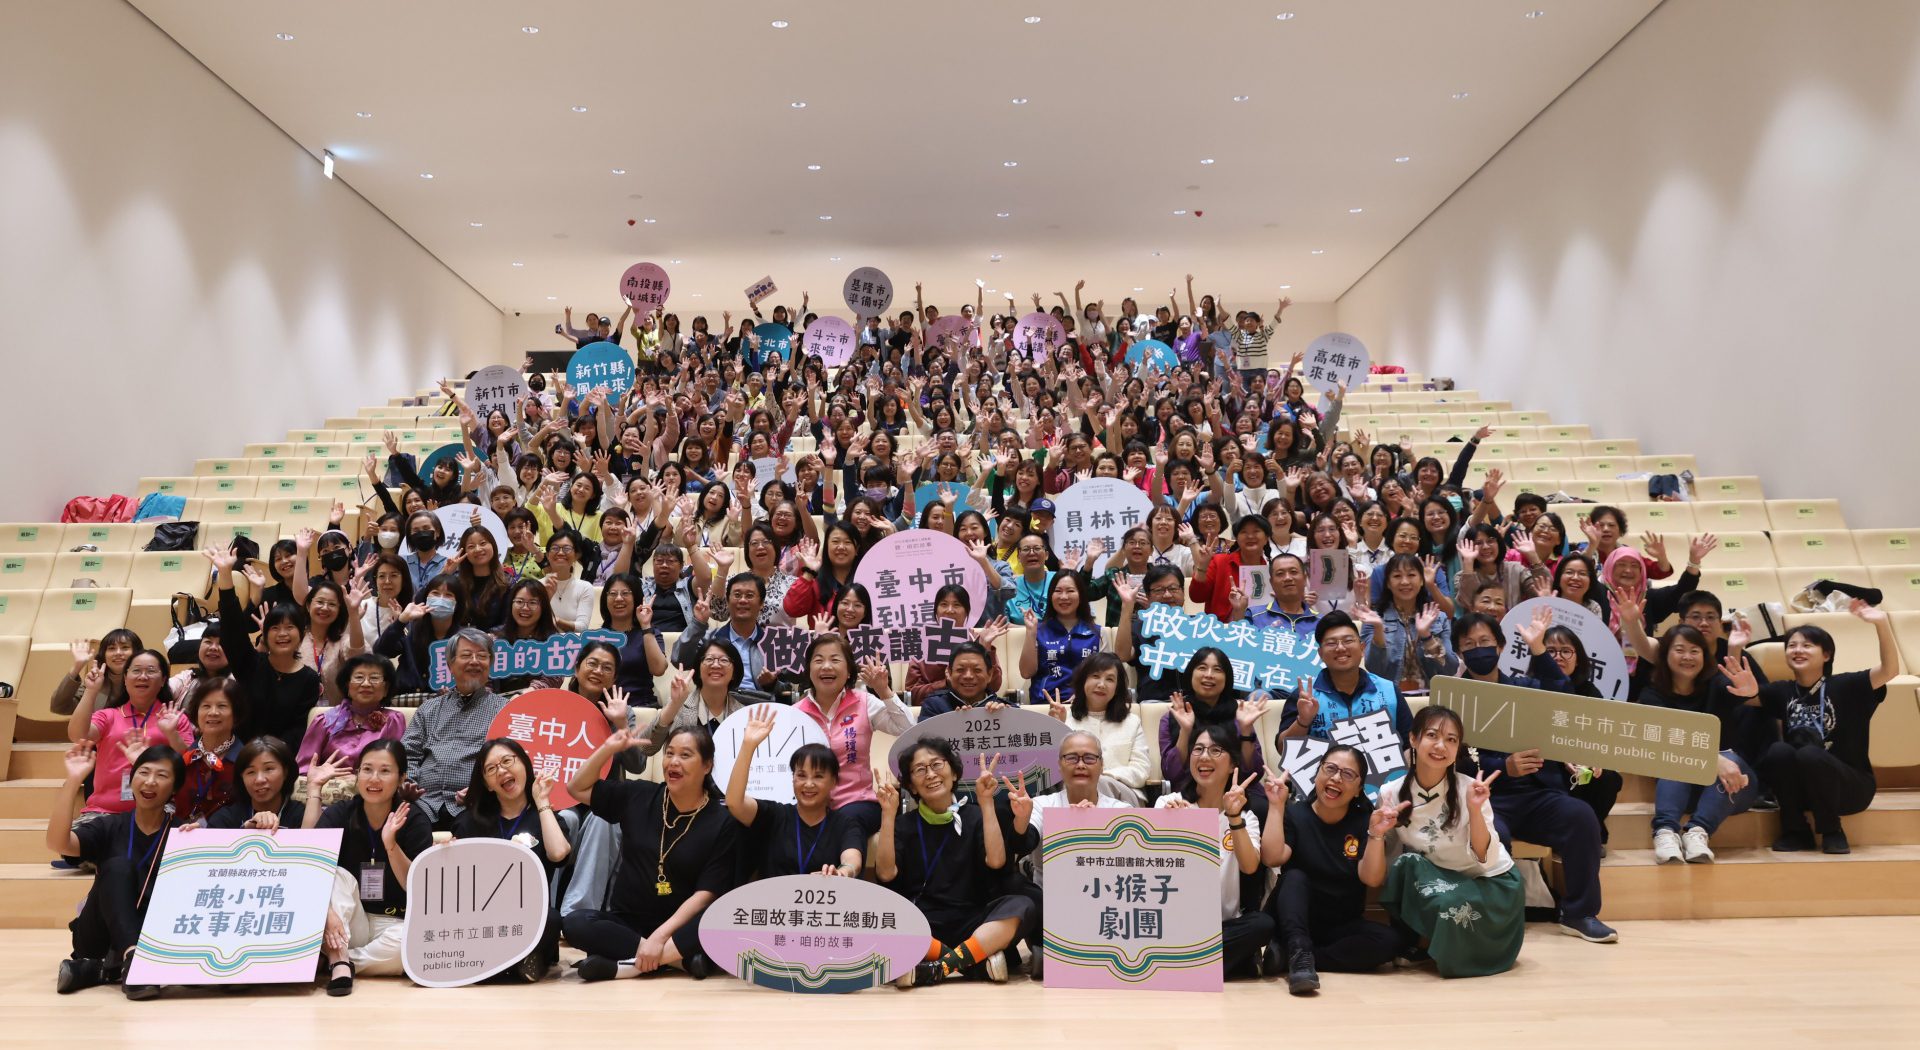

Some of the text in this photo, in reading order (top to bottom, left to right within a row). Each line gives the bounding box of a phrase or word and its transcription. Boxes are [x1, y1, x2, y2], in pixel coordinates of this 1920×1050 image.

[627, 276, 664, 290] 南投縣
[851, 278, 886, 297] 基隆市
[813, 329, 849, 345] 斗六市
[576, 360, 625, 379] 新竹縣
[1314, 349, 1361, 370] 高雄市
[1309, 366, 1352, 386] 來也!
[475, 383, 519, 401] 新竹市
[1067, 507, 1140, 532] 員林市
[875, 563, 965, 599] 臺中市
[764, 620, 968, 672] 做來講古
[506, 713, 596, 750] 臺中人
[965, 718, 1001, 733] 2025
[1551, 709, 1711, 750] 臺中市立圖書館
[1551, 734, 1708, 770] taichung public library
[1076, 856, 1186, 868] 臺中市立圖書館大雅分館
[208, 868, 288, 878] 宜蘭縣政府文化局
[194, 883, 285, 909] 醜小鴨
[794, 889, 837, 905] 2025
[1082, 873, 1179, 905] 小猴子
[173, 910, 295, 937] 故事劇團
[733, 908, 897, 930] 全國故事志工總動員
[1099, 906, 1163, 940] 劇團
[423, 924, 523, 943] 臺中市立圖書館
[423, 950, 465, 959] taichung
[423, 960, 485, 971] public library
